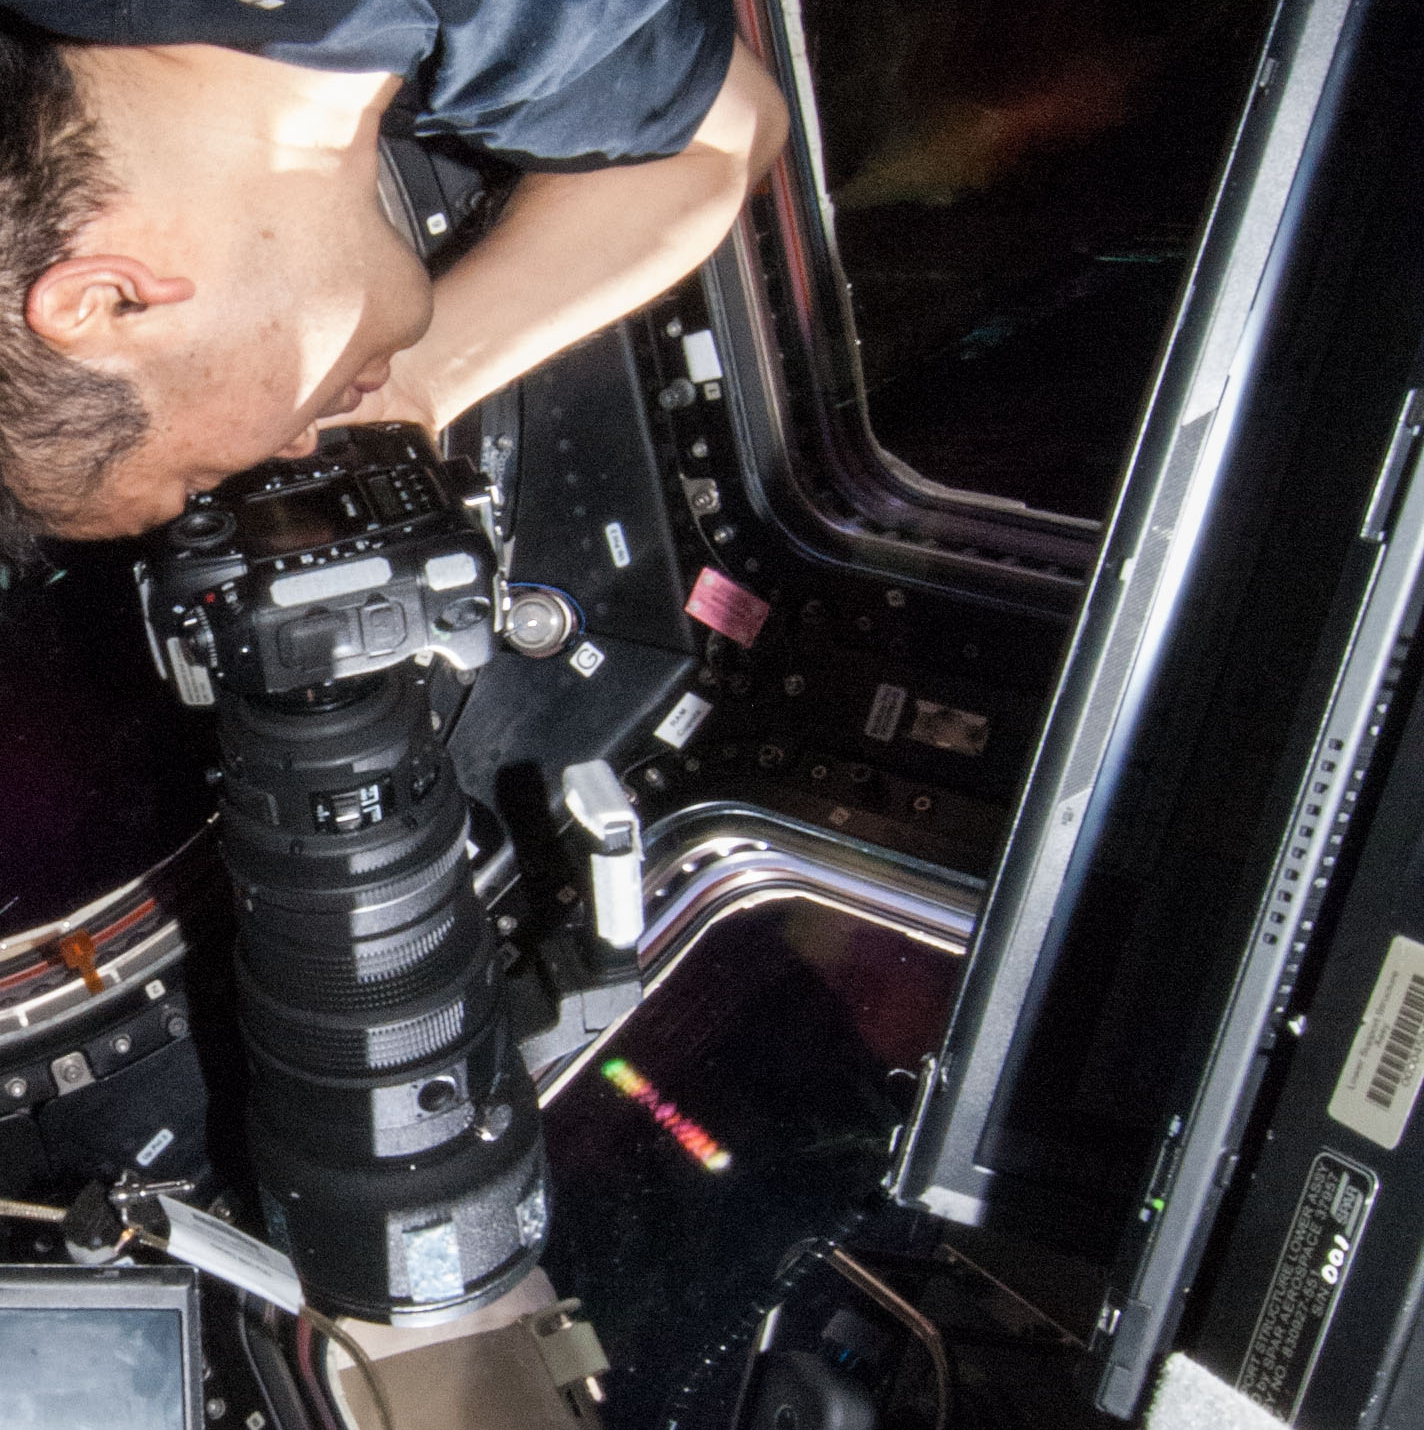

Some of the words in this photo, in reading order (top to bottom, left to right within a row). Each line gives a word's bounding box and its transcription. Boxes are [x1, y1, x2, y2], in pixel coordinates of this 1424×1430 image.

[576, 648, 597, 669] G
[1345, 1058, 1366, 1091] Lower
[1358, 1016, 1383, 1058] Support
[1374, 968, 1401, 1017] Structure
[1332, 1183, 1361, 1227] SPAR
[1251, 1262, 1298, 1353] STRUCTURE
[1284, 1204, 1316, 1262] LOWER
[1304, 1161, 1331, 1205] ASSY
[1317, 1232, 1353, 1286] 001
[1261, 1325, 1288, 1369] SPAR
[1275, 1222, 1325, 1325] AEROSPACE
[1309, 1286, 1333, 1318] S/N
